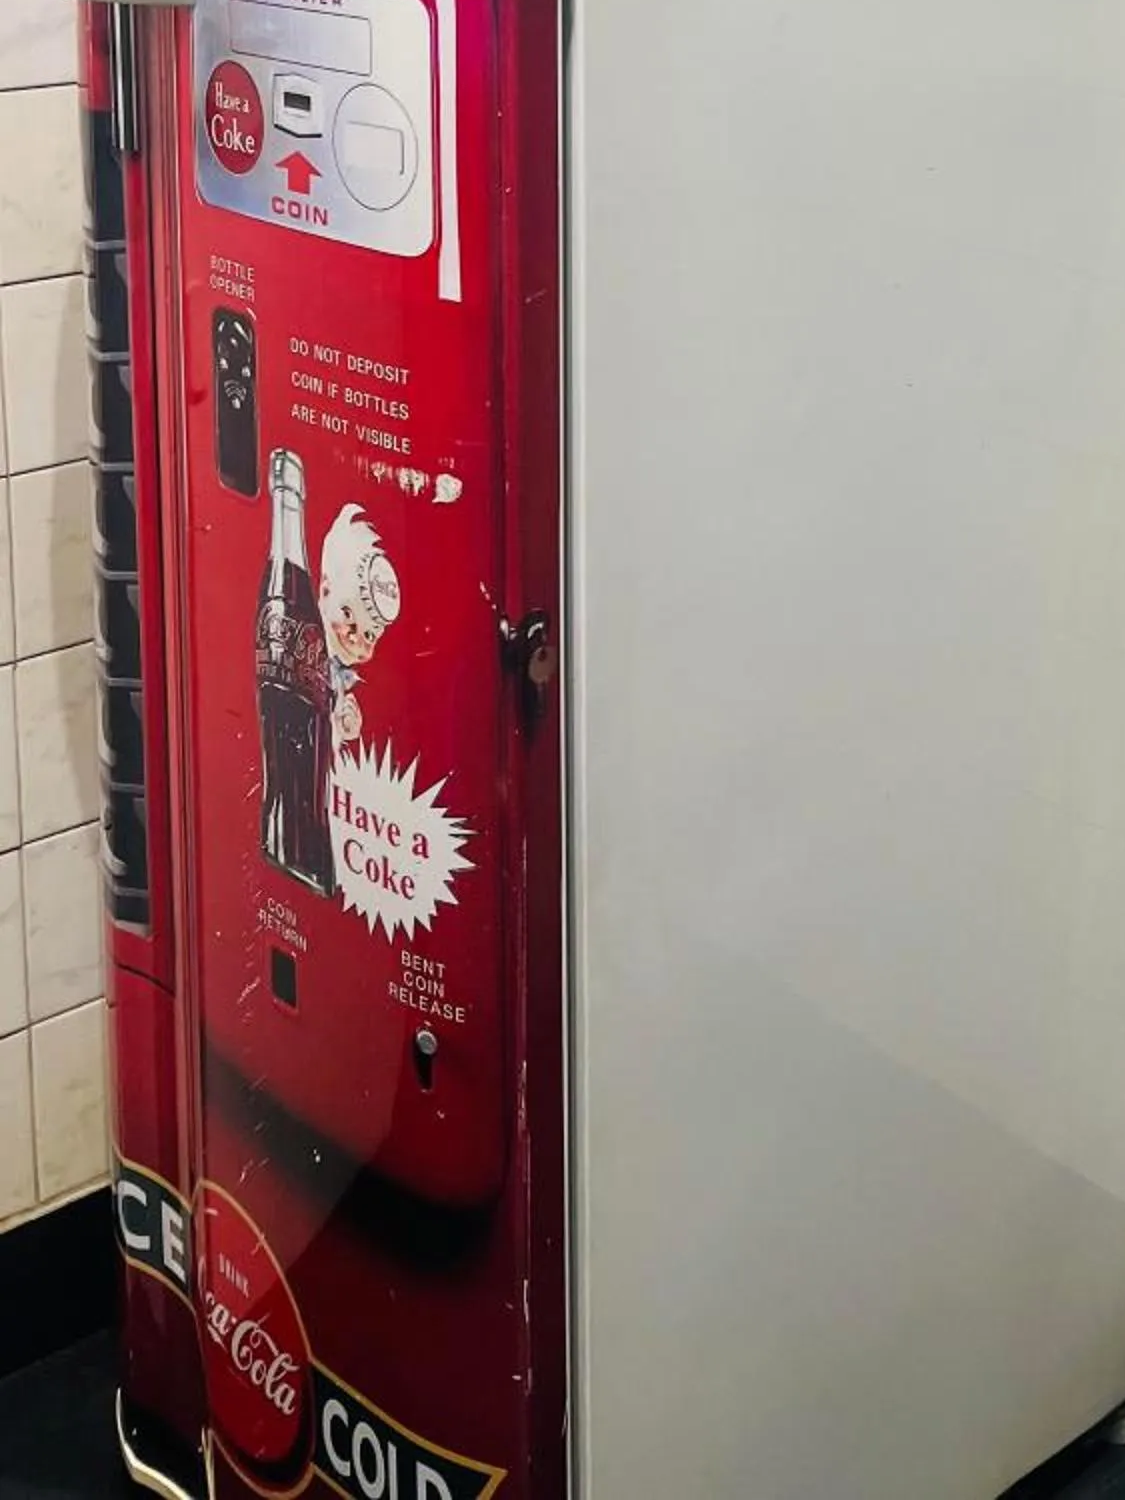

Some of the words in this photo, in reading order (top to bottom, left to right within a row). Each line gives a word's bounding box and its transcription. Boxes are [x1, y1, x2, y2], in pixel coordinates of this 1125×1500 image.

[215, 82, 241, 112] Have
[241, 99, 250, 113] a
[211, 114, 255, 154] Coke
[271, 196, 329, 227] COIN
[209, 275, 255, 303] OPENER
[210, 255, 255, 283] BOTTLE
[290, 337, 309, 356] DO
[313, 345, 342, 367] NOT
[348, 354, 410, 385] DEPOSIT
[291, 371, 323, 395] COIN
[328, 383, 339, 398] IF
[345, 388, 409, 421] BOTTLES
[291, 404, 317, 425] ARE
[322, 413, 349, 435] NOT
[355, 424, 413, 455] VISIBLE
[333, 785, 401, 847] Have
[411, 832, 430, 859] a
[343, 838, 415, 900] Coke
[259, 908, 308, 952] RETURN
[267, 897, 297, 927] COIN
[401, 950, 446, 978] BENT
[403, 971, 445, 998] COIN
[389, 981, 467, 1024] RELEASE
[117, 1179, 186, 1284] CE
